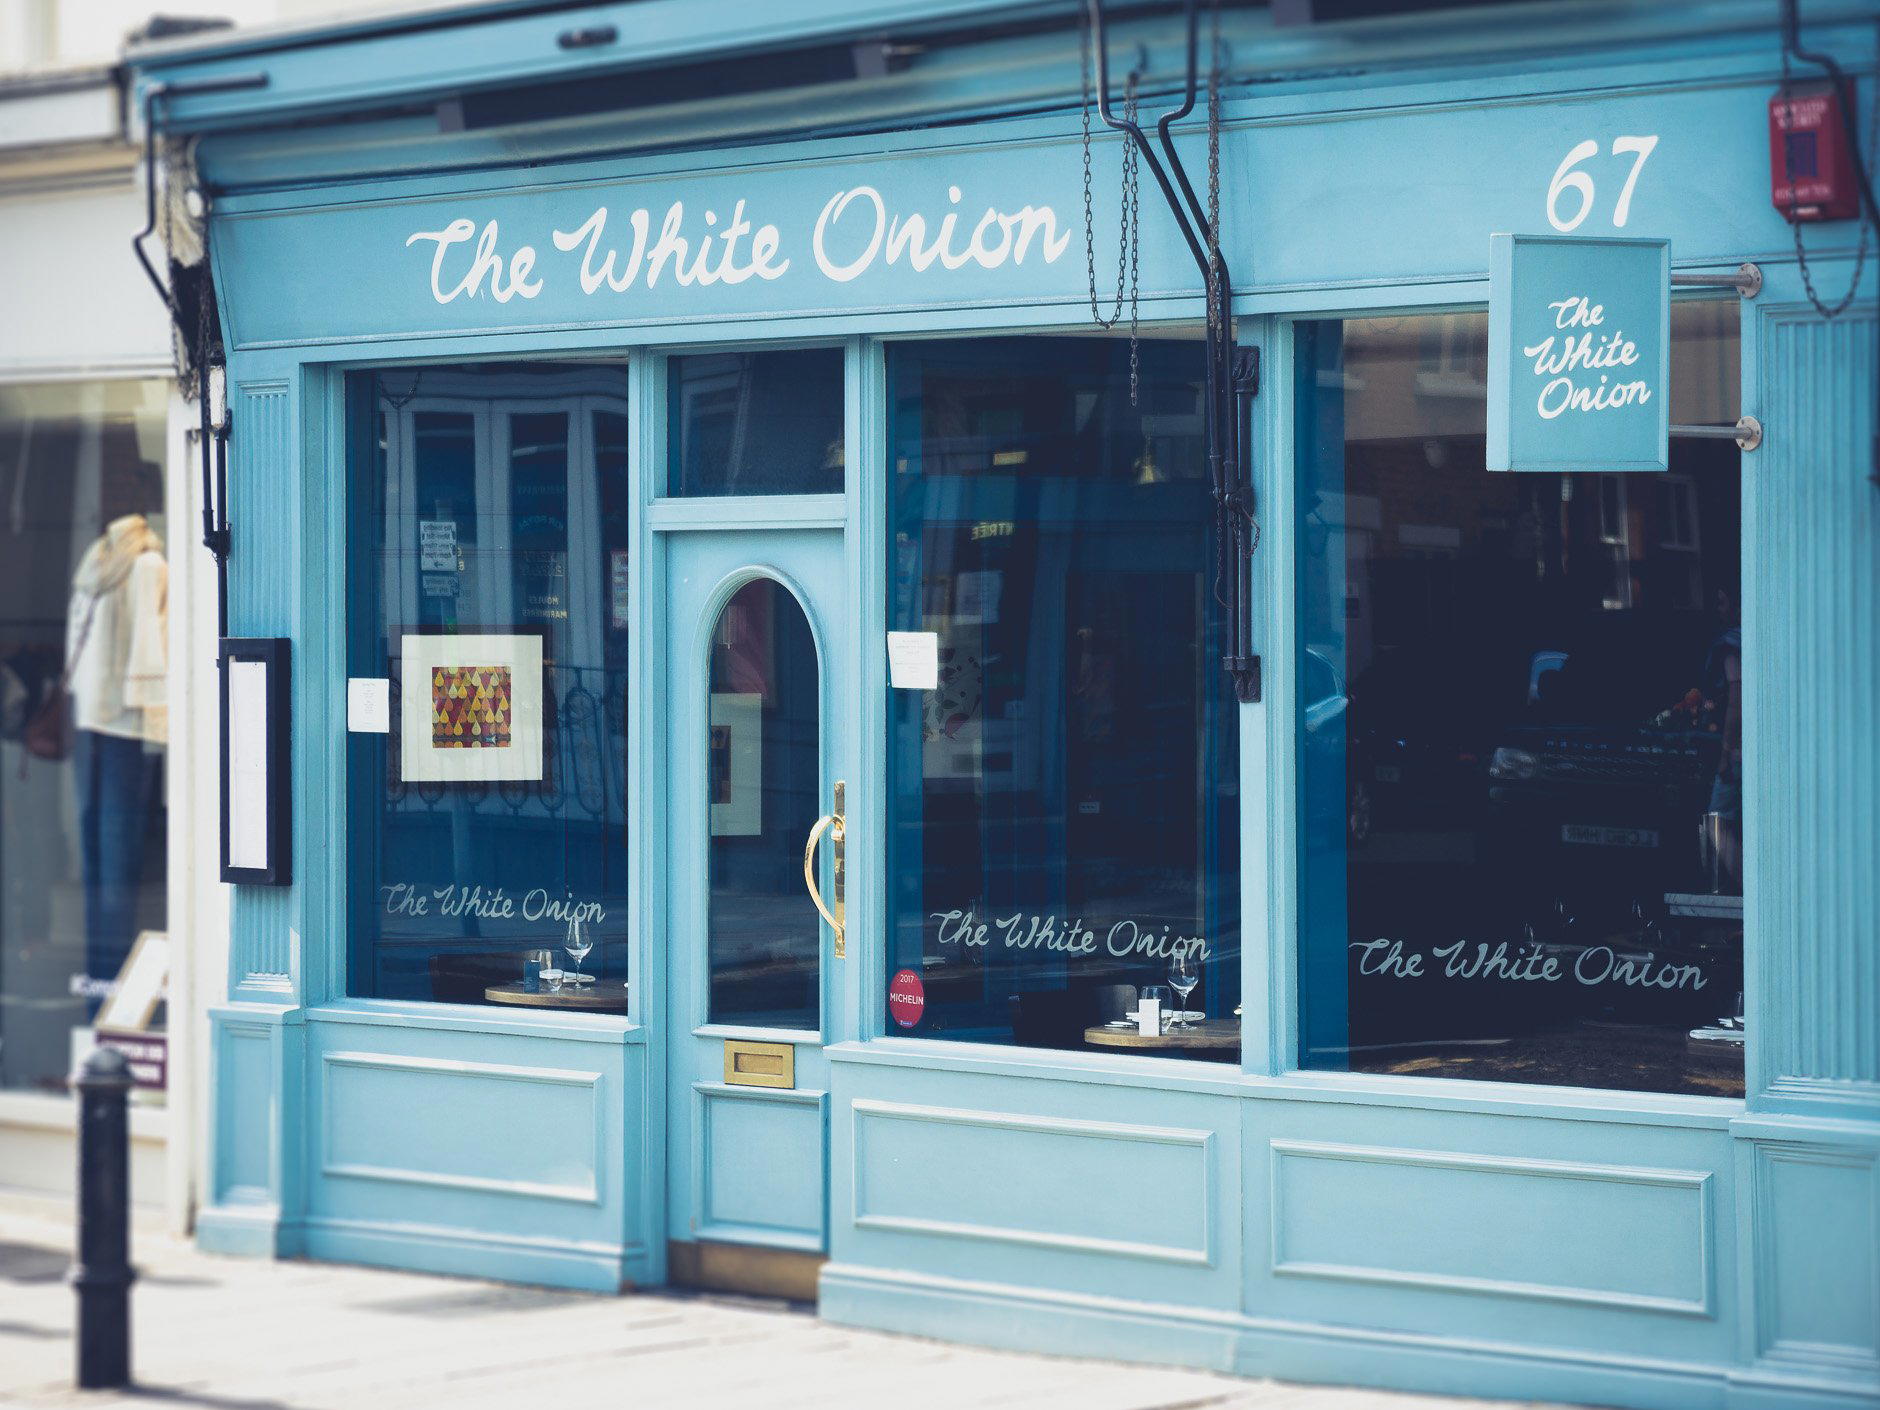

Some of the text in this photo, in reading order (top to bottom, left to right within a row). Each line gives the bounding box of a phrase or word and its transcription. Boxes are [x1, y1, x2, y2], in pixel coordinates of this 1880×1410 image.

[1545, 135, 1660, 232] 67
[405, 185, 1072, 304] The White Onion
[1547, 296, 1605, 330] The
[1523, 330, 1640, 376] White
[1536, 374, 1652, 420] Onion
[380, 883, 606, 924] The White Onion
[930, 909, 1212, 962] The White Onion
[899, 974, 915, 984] 2017
[1348, 938, 1708, 990] The White Onion
[889, 992, 925, 1006] MICHELIN
